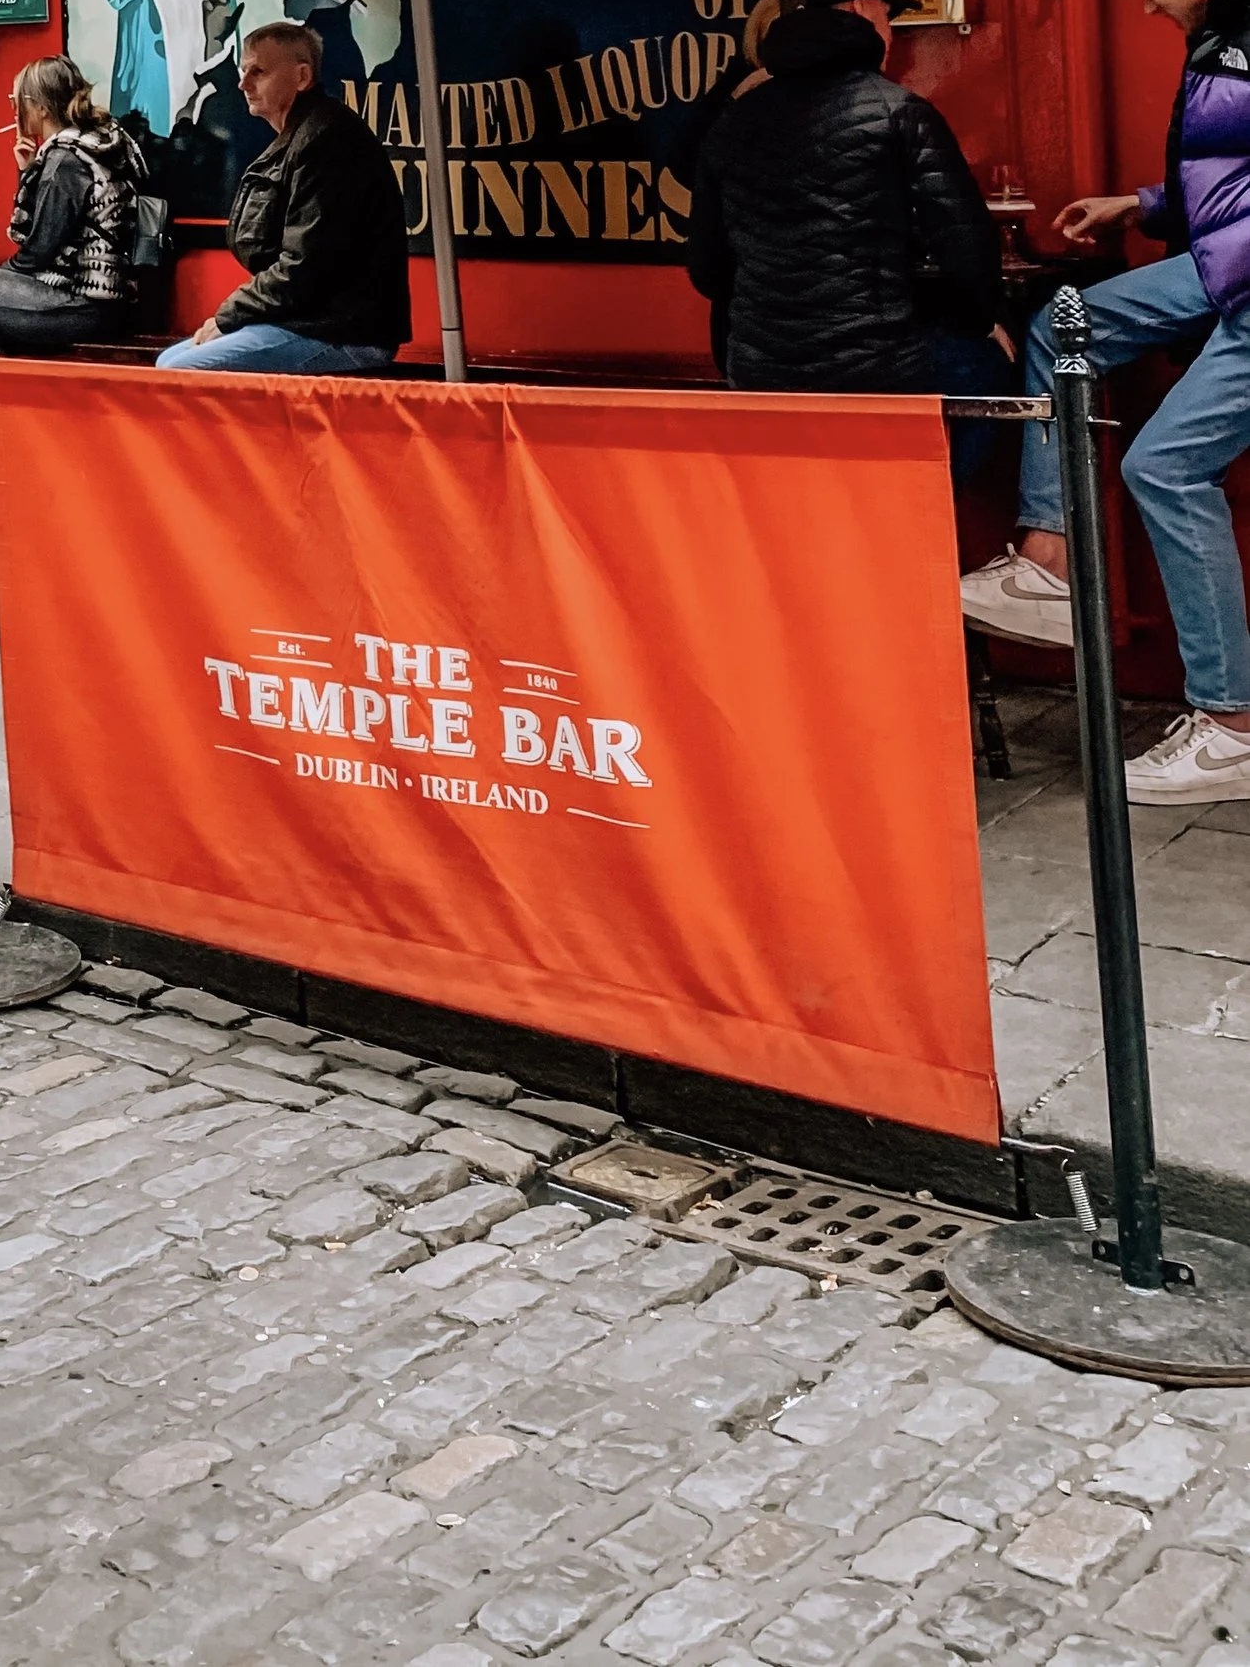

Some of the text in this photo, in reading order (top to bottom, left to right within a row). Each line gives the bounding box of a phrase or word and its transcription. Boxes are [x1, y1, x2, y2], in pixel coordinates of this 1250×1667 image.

[341, 76, 537, 149] MATED
[278, 633, 558, 692] Est. THE 1840
[204, 656, 653, 789] TEMPLE BAR
[295, 752, 549, 815] DUBLIN IRELAND
